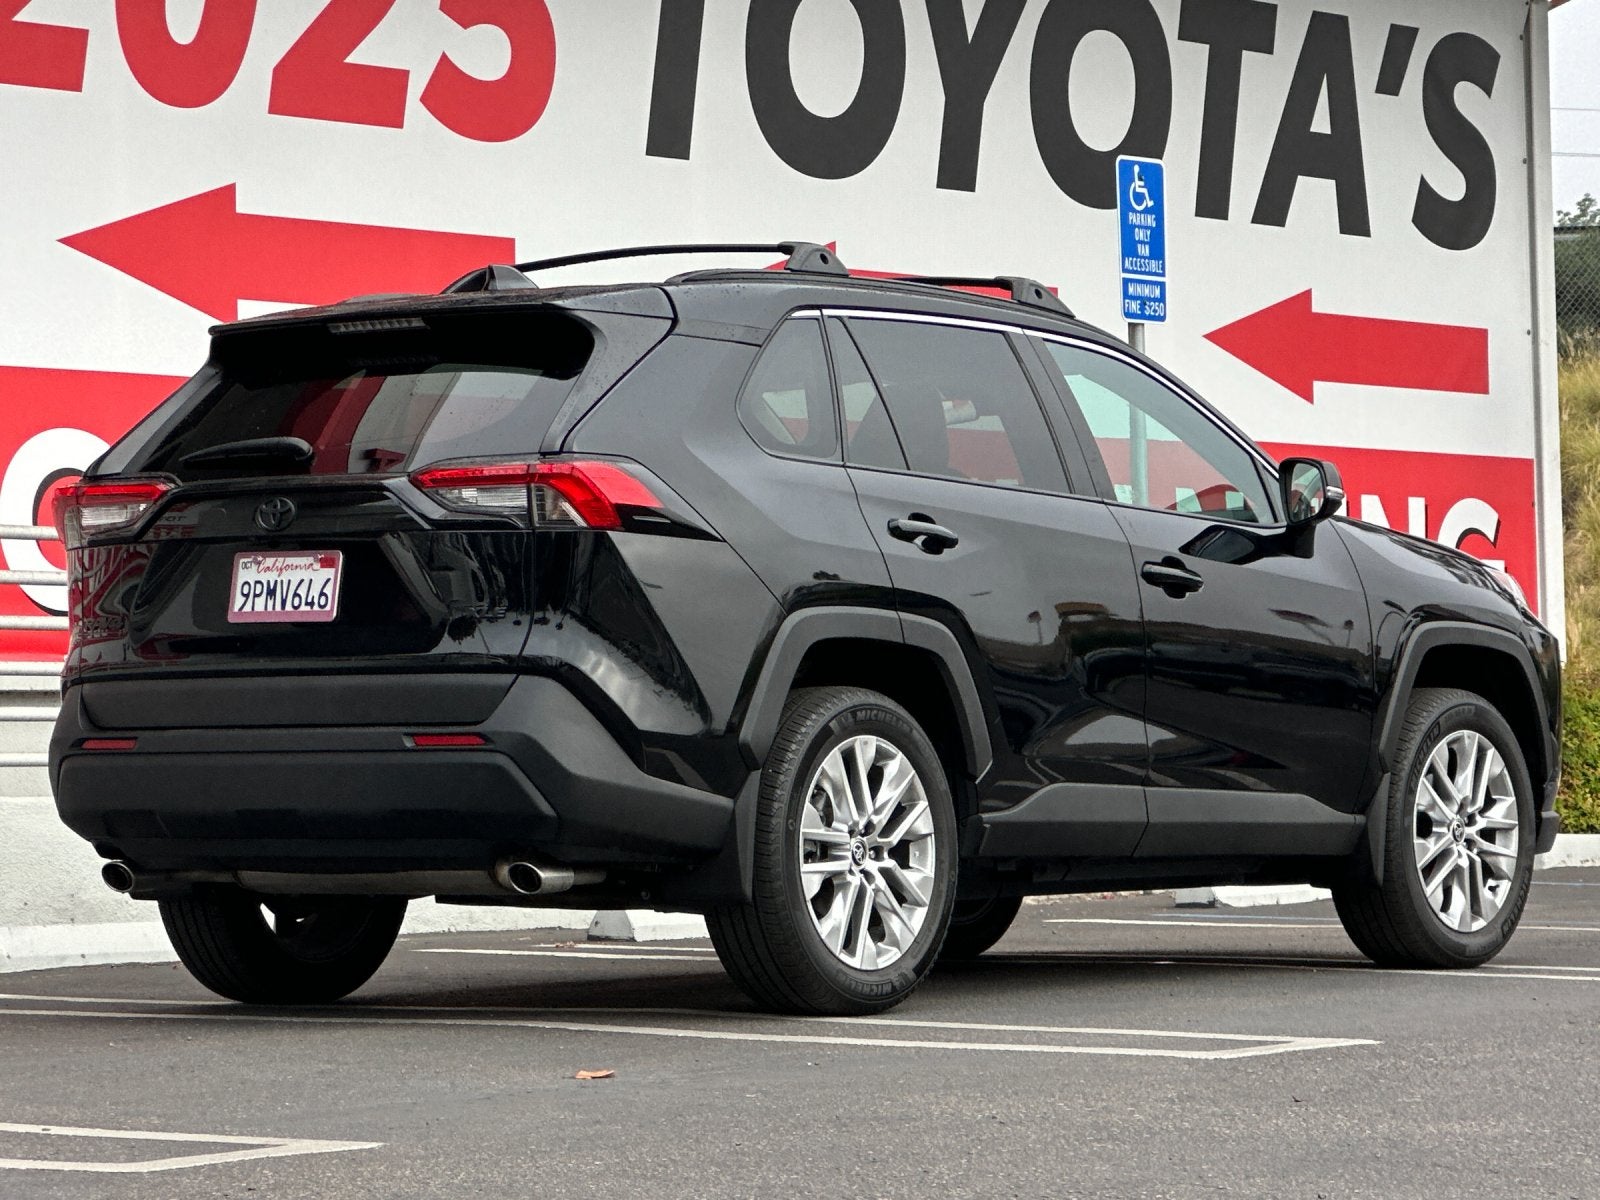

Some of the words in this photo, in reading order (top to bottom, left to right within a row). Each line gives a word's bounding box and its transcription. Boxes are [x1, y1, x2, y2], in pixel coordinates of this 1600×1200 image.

[1128, 212, 1156, 227] PARKING
[1134, 228, 1151, 242] ONLY
[1137, 244, 1150, 256] VAN
[1124, 257, 1163, 273] ACCESSIBLE
[1128, 282, 1161, 299] MINIMUM
[1125, 299, 1142, 315] FINE
[1144, 301, 1164, 317] $250
[255, 558, 320, 577] California
[238, 578, 332, 611] 9PMV646
